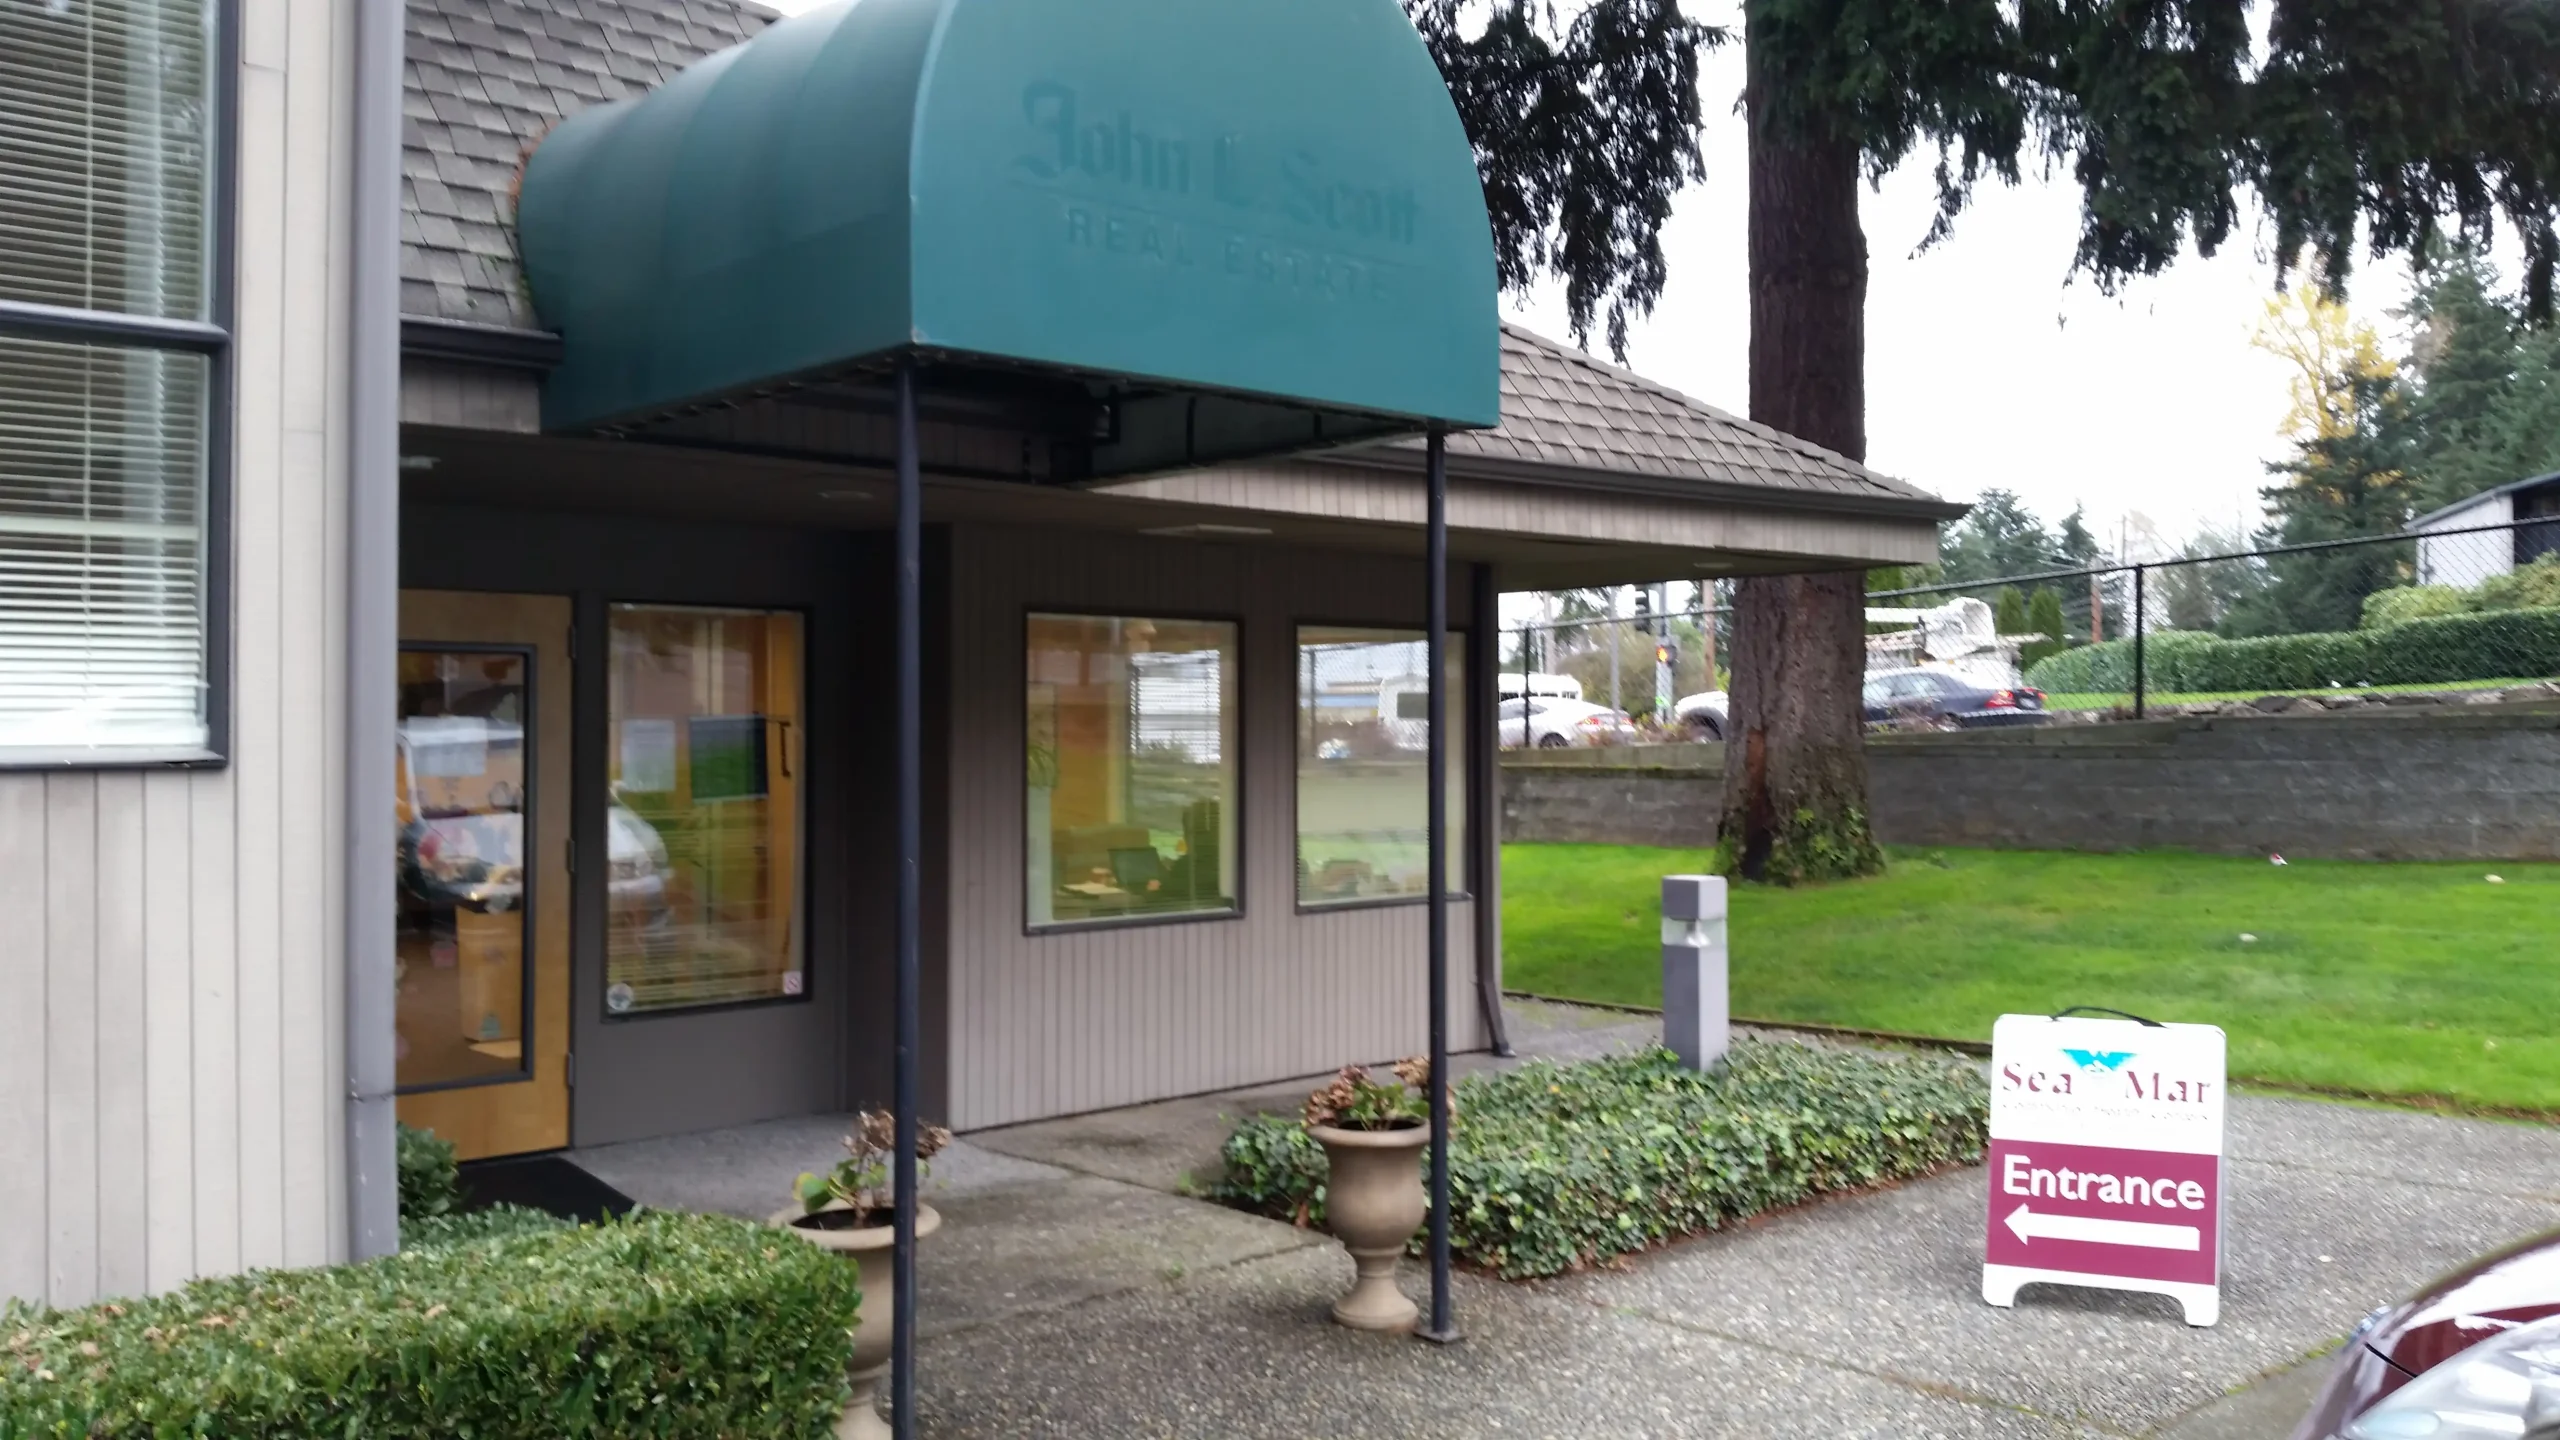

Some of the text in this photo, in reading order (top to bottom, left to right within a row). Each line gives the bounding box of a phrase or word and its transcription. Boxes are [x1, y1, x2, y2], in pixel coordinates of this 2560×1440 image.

[1066, 206, 1391, 301] REAL ESTATE
[2003, 1062, 2211, 1103] Sea Mar
[2003, 1153, 2206, 1210] Entrance
